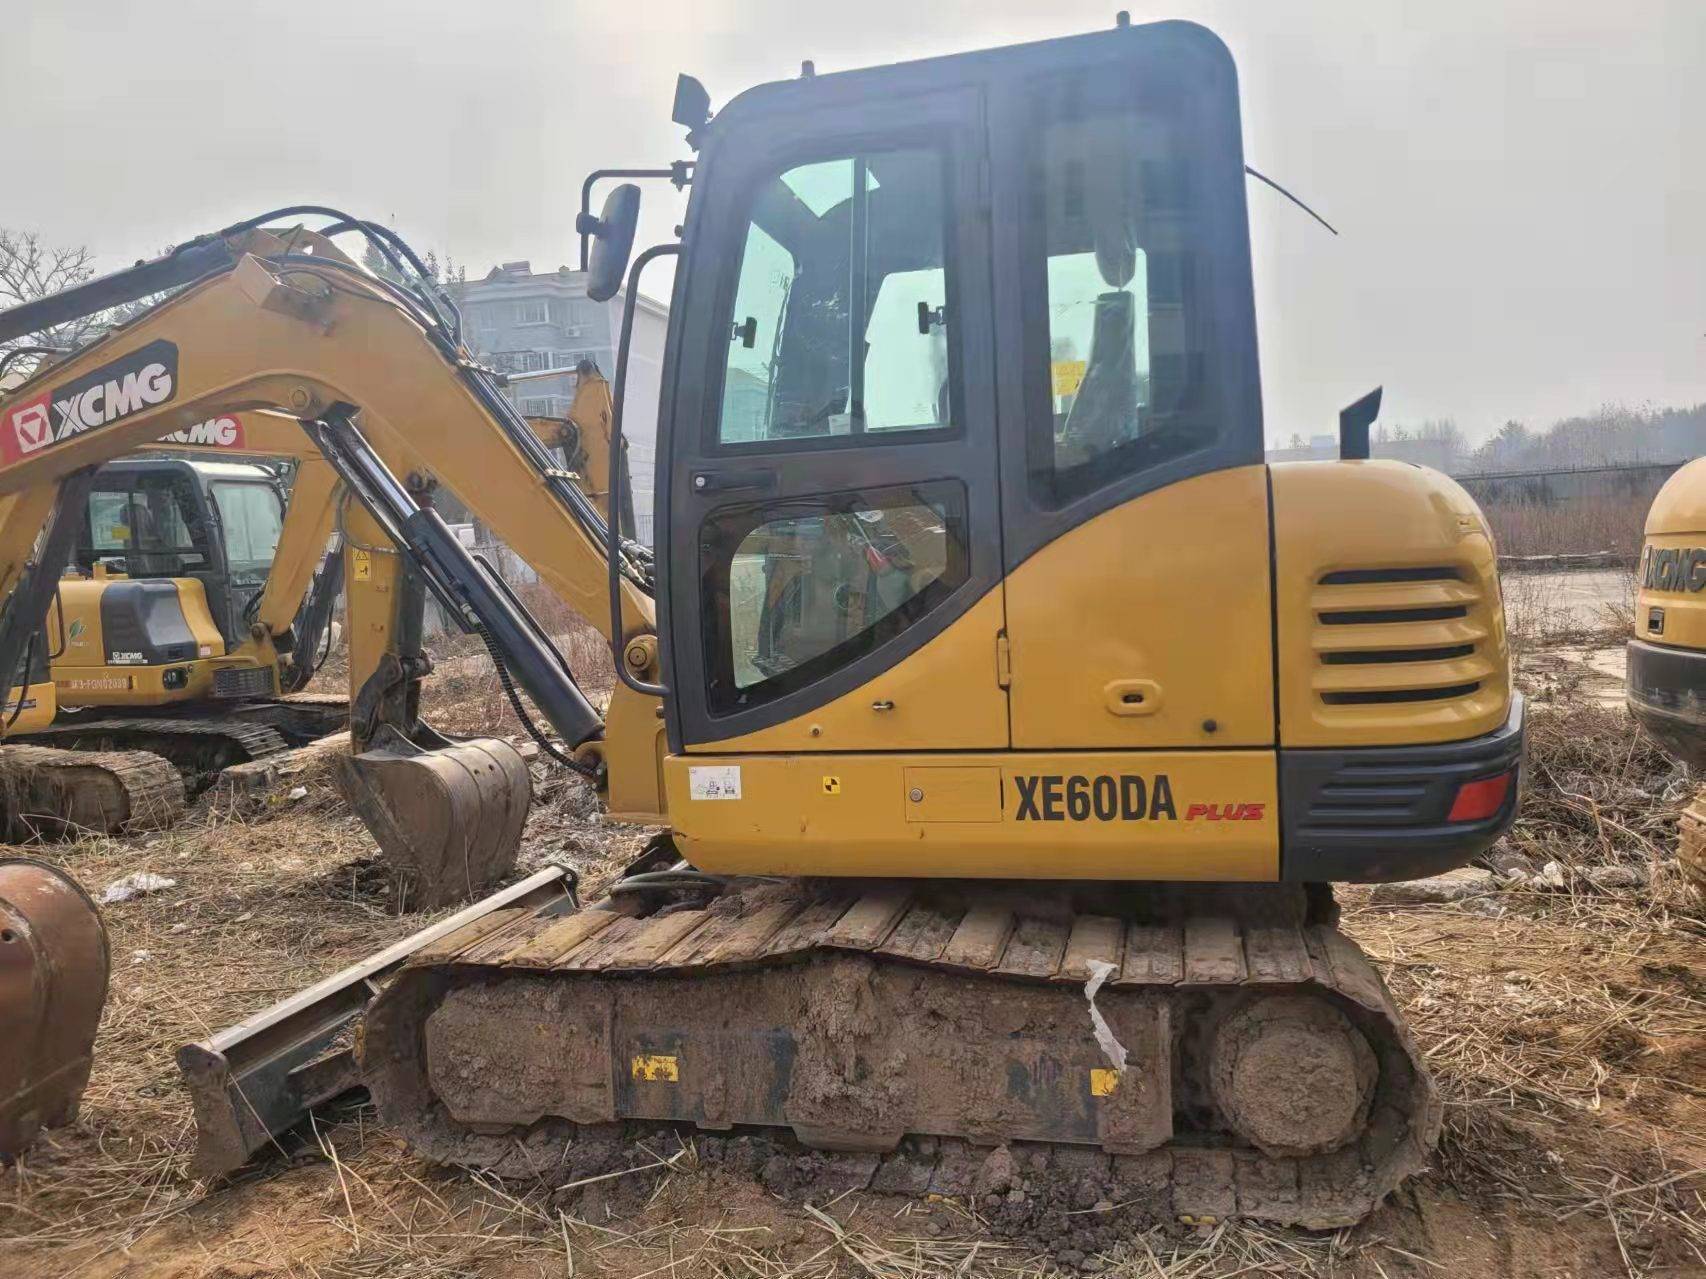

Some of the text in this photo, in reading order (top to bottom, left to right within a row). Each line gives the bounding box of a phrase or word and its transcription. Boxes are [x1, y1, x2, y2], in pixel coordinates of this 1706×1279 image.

[52, 363, 172, 441] XCMG
[1014, 774, 1266, 821] XE60DA PLUS
